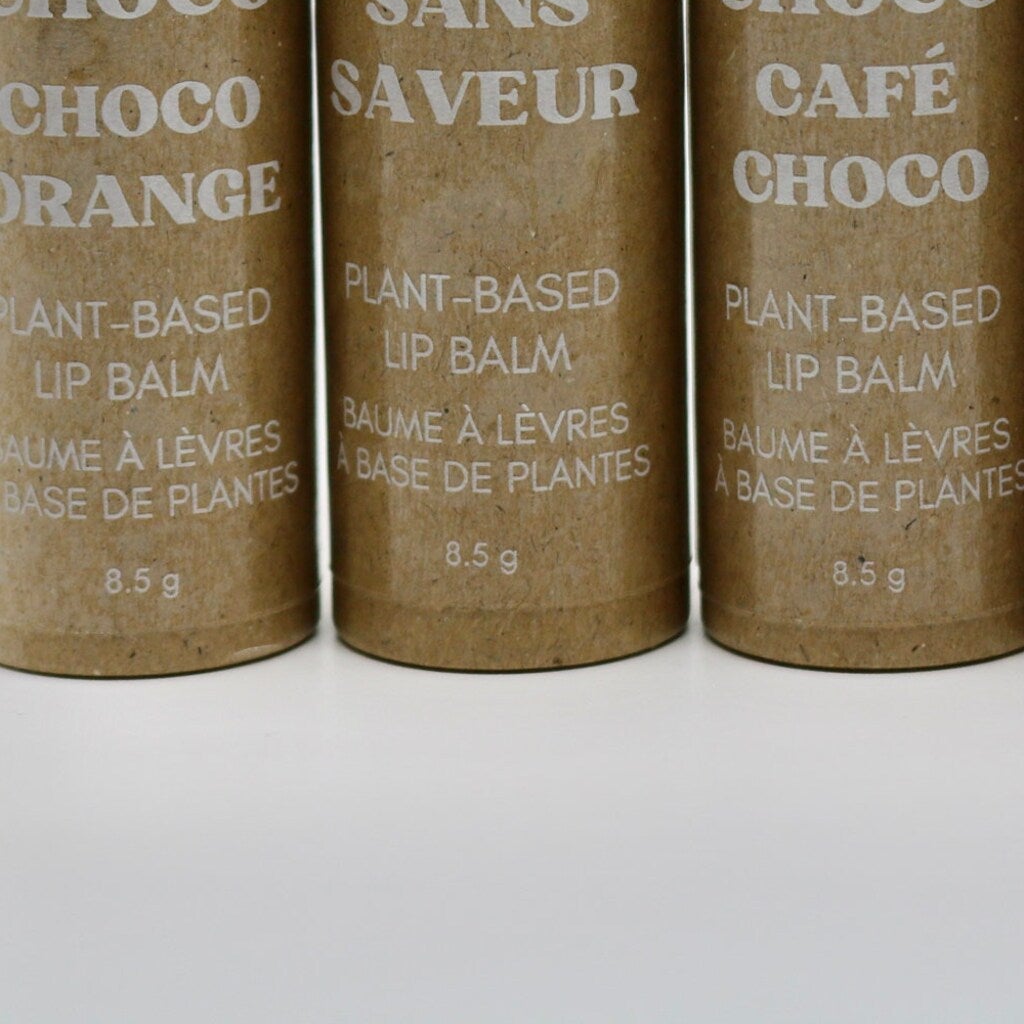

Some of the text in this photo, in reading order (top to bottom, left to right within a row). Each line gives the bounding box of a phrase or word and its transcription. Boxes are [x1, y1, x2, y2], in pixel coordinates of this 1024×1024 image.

[331, 60, 639, 127] SAVEUR
[755, 42, 957, 118] CAFÉ
[0, 76, 260, 137] CHOCO
[732, 149, 990, 209] CHOCO
[344, 262, 620, 314] PLANT-BASED
[726, 285, 1000, 334] PLANT-BASED
[34, 355, 229, 400] LIP BALM
[384, 330, 573, 374] LIP BALM
[767, 351, 956, 394] LIP BALM
[343, 394, 629, 445] BAUME À LÈVRES
[723, 417, 1012, 465] BAUME À LÈVRES
[0, 421, 280, 472] AUME À LÈVRES
[336, 431, 651, 494] À BASE DE PLANTES
[4, 461, 298, 520] BASE DE PLANTES
[715, 454, 730, 496] À
[736, 468, 815, 512] BASE
[831, 481, 879, 513] DE
[105, 568, 180, 599] 8.5 g
[446, 541, 518, 575] 8.5 g
[833, 560, 905, 593] 8.5 g
